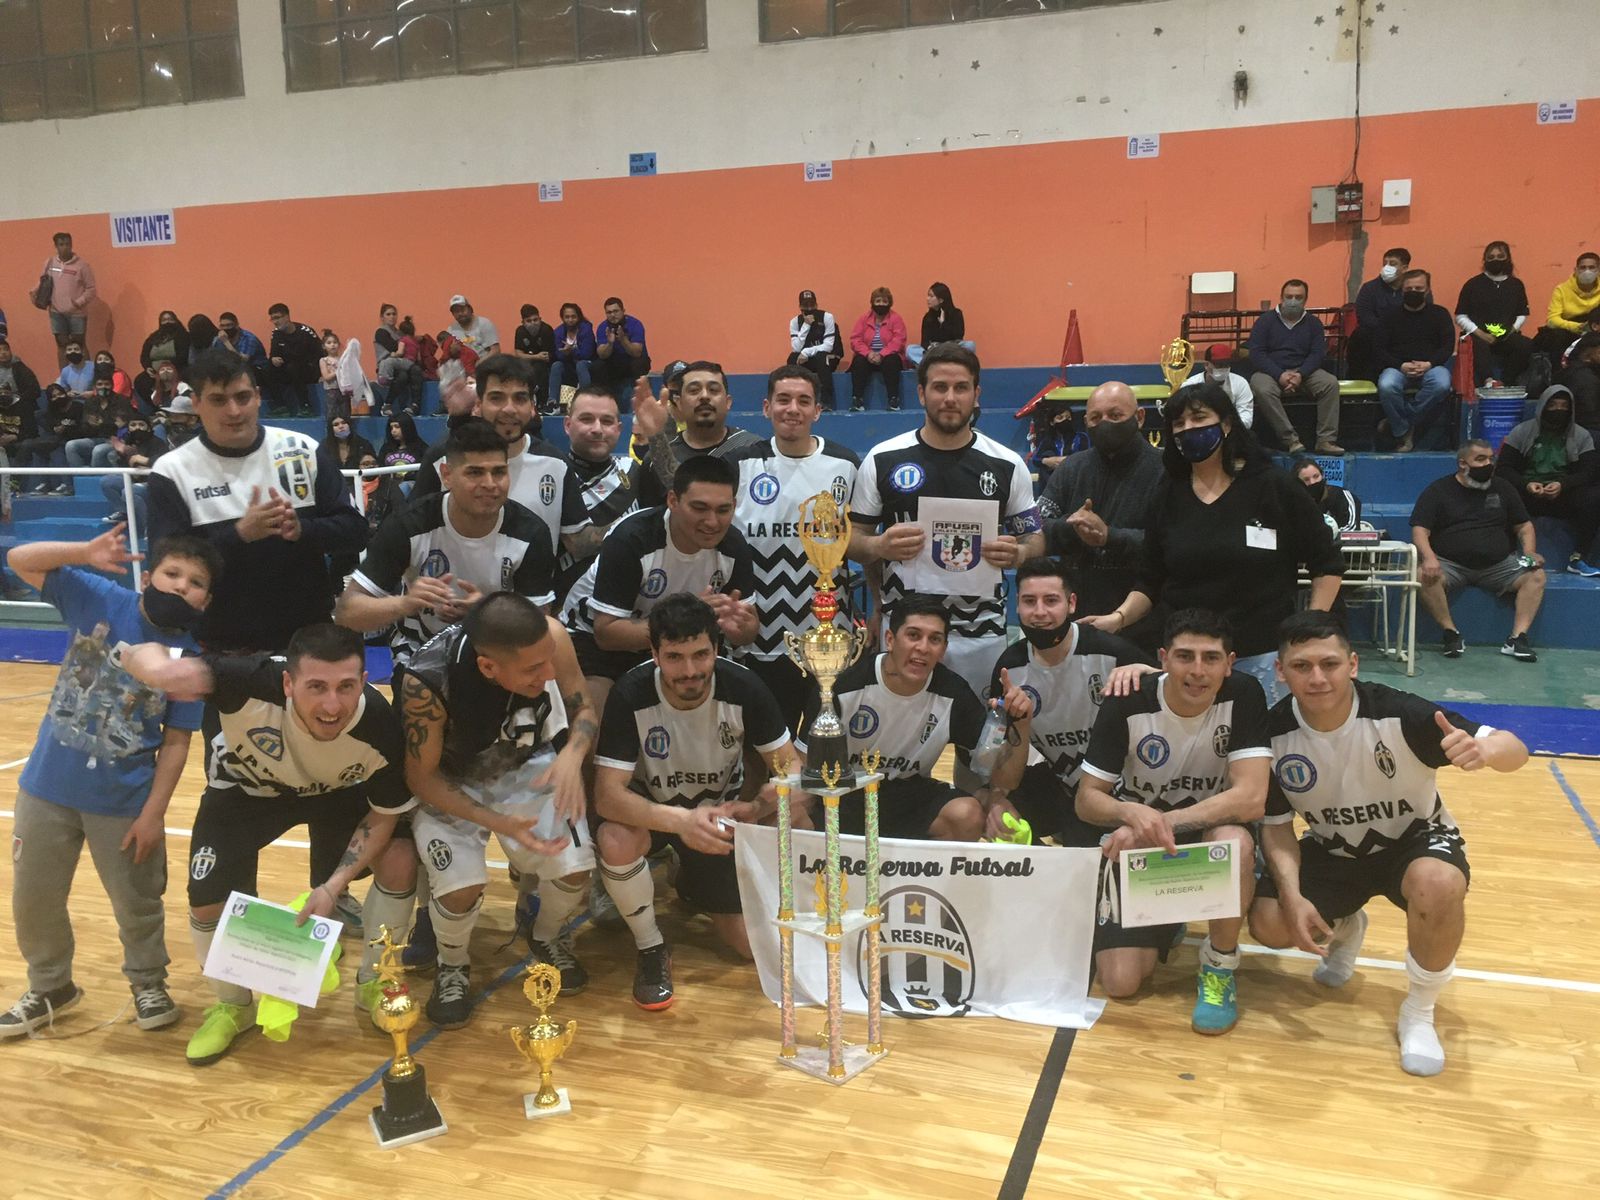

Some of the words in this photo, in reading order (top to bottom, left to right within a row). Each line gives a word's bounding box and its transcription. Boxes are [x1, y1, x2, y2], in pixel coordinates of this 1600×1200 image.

[114, 214, 171, 243] VISITANTE
[193, 483, 232, 501] Futsal
[747, 522, 768, 538] LA
[935, 522, 980, 531] AFUSA
[651, 775, 662, 788] A
[667, 770, 724, 788] RESER
[1133, 776, 1155, 794] LA
[1303, 811, 1319, 825] A
[1321, 798, 1414, 826] RESERVA
[838, 856, 943, 877] Reerva
[949, 856, 1034, 877] Futsal
[1155, 888, 1165, 896] LA
[1166, 885, 1204, 895] RESERVA
[891, 929, 965, 956] RESERVA
